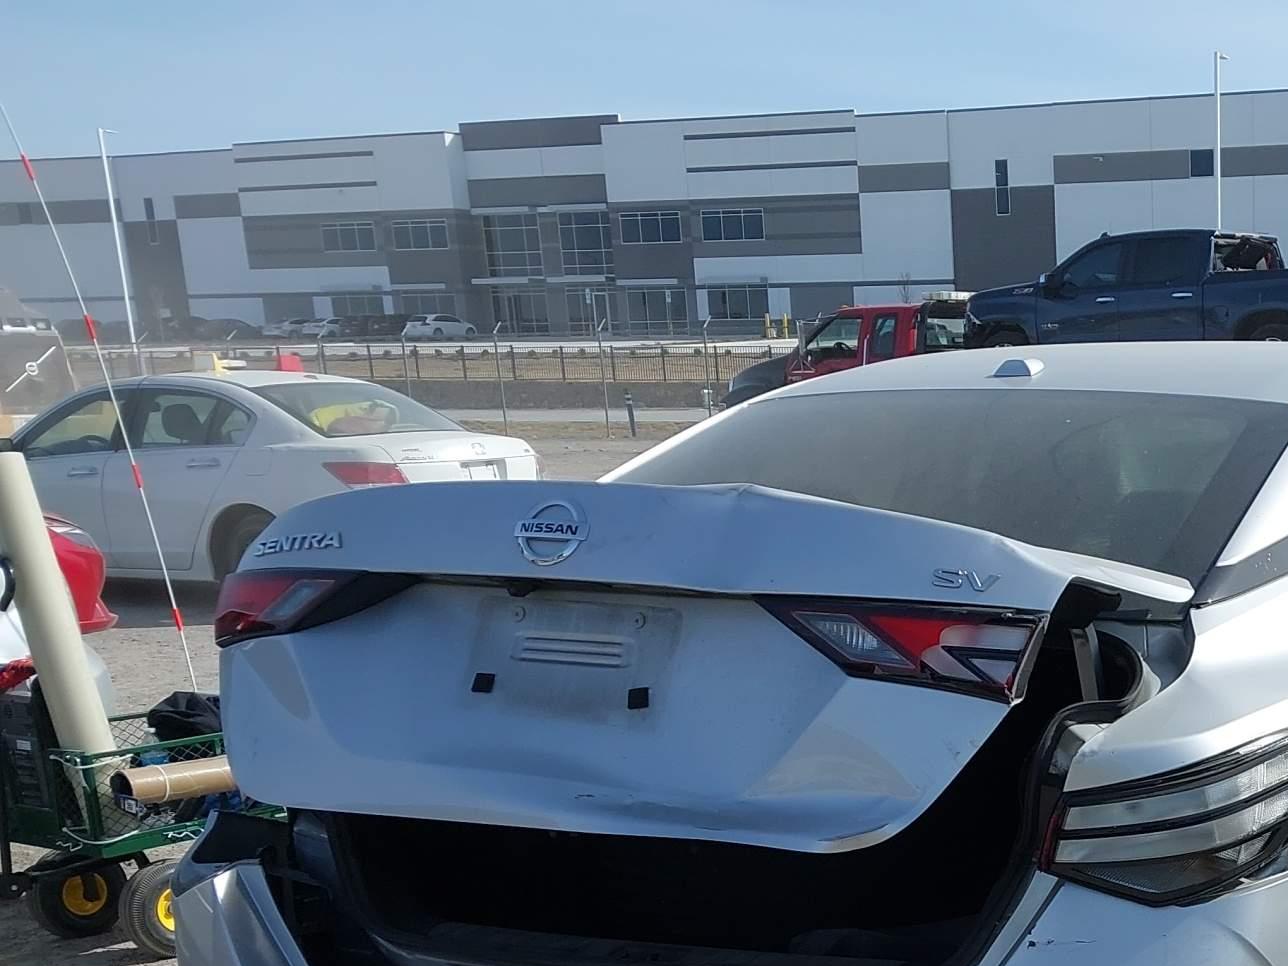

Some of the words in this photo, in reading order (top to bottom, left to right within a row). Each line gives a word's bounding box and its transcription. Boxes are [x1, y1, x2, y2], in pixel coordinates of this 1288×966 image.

[520, 522, 579, 536] NISSAN
[253, 531, 343, 557] SENTRA
[931, 568, 1001, 593] SV
